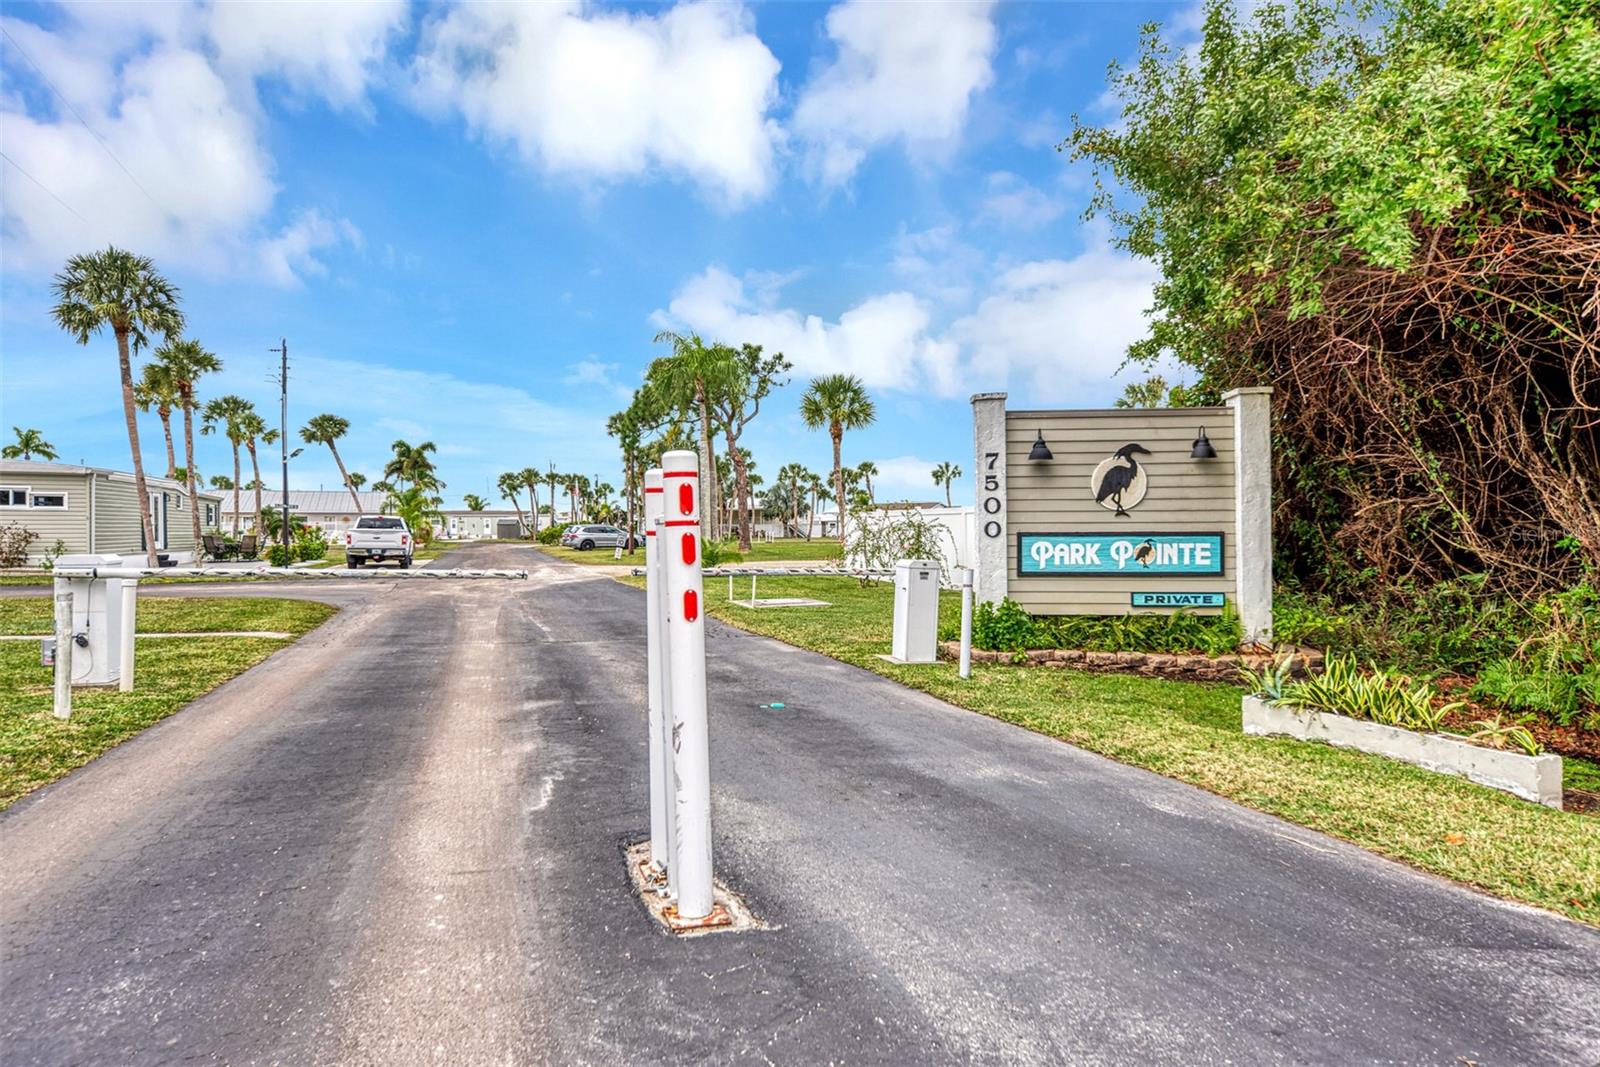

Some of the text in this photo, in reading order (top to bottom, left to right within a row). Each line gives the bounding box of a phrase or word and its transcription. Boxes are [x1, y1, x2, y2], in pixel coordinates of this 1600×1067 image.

[984, 452, 1001, 538] 7500
[1031, 540, 1211, 569] PARK POINTE
[1144, 595, 1213, 604] PRIVATE
